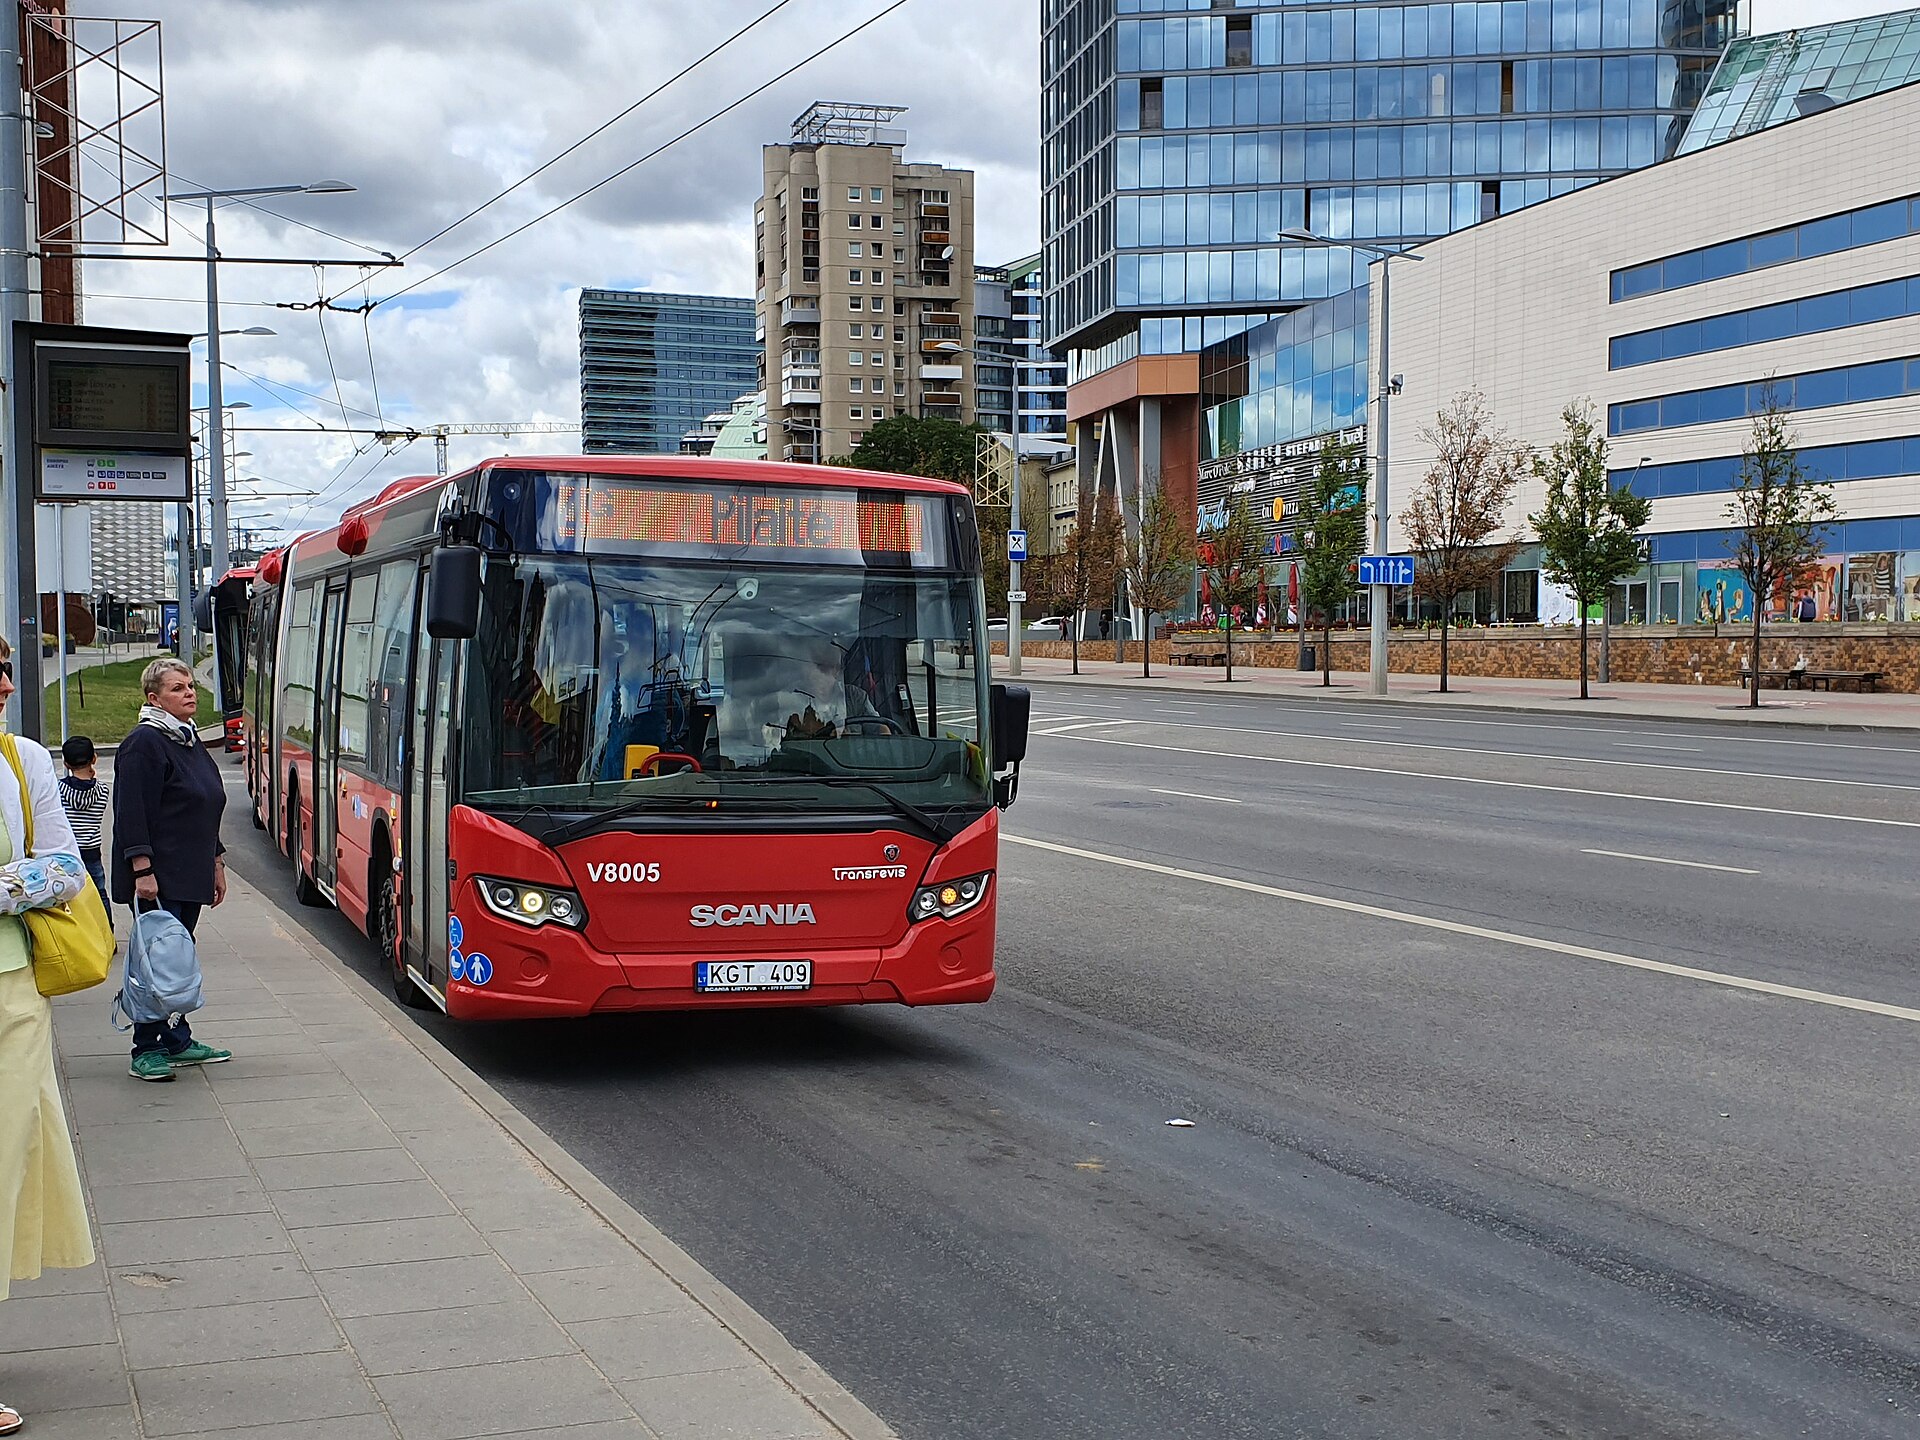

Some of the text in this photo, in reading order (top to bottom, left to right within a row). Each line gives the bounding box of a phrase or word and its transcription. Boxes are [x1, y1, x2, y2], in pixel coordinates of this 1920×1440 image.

[1282, 502, 1299, 516] PIZZA
[587, 862, 660, 883] V8005
[832, 864, 908, 881] Transrevis
[689, 903, 816, 926] SCANIA
[711, 965, 755, 983] KGT
[771, 964, 806, 983] 409
